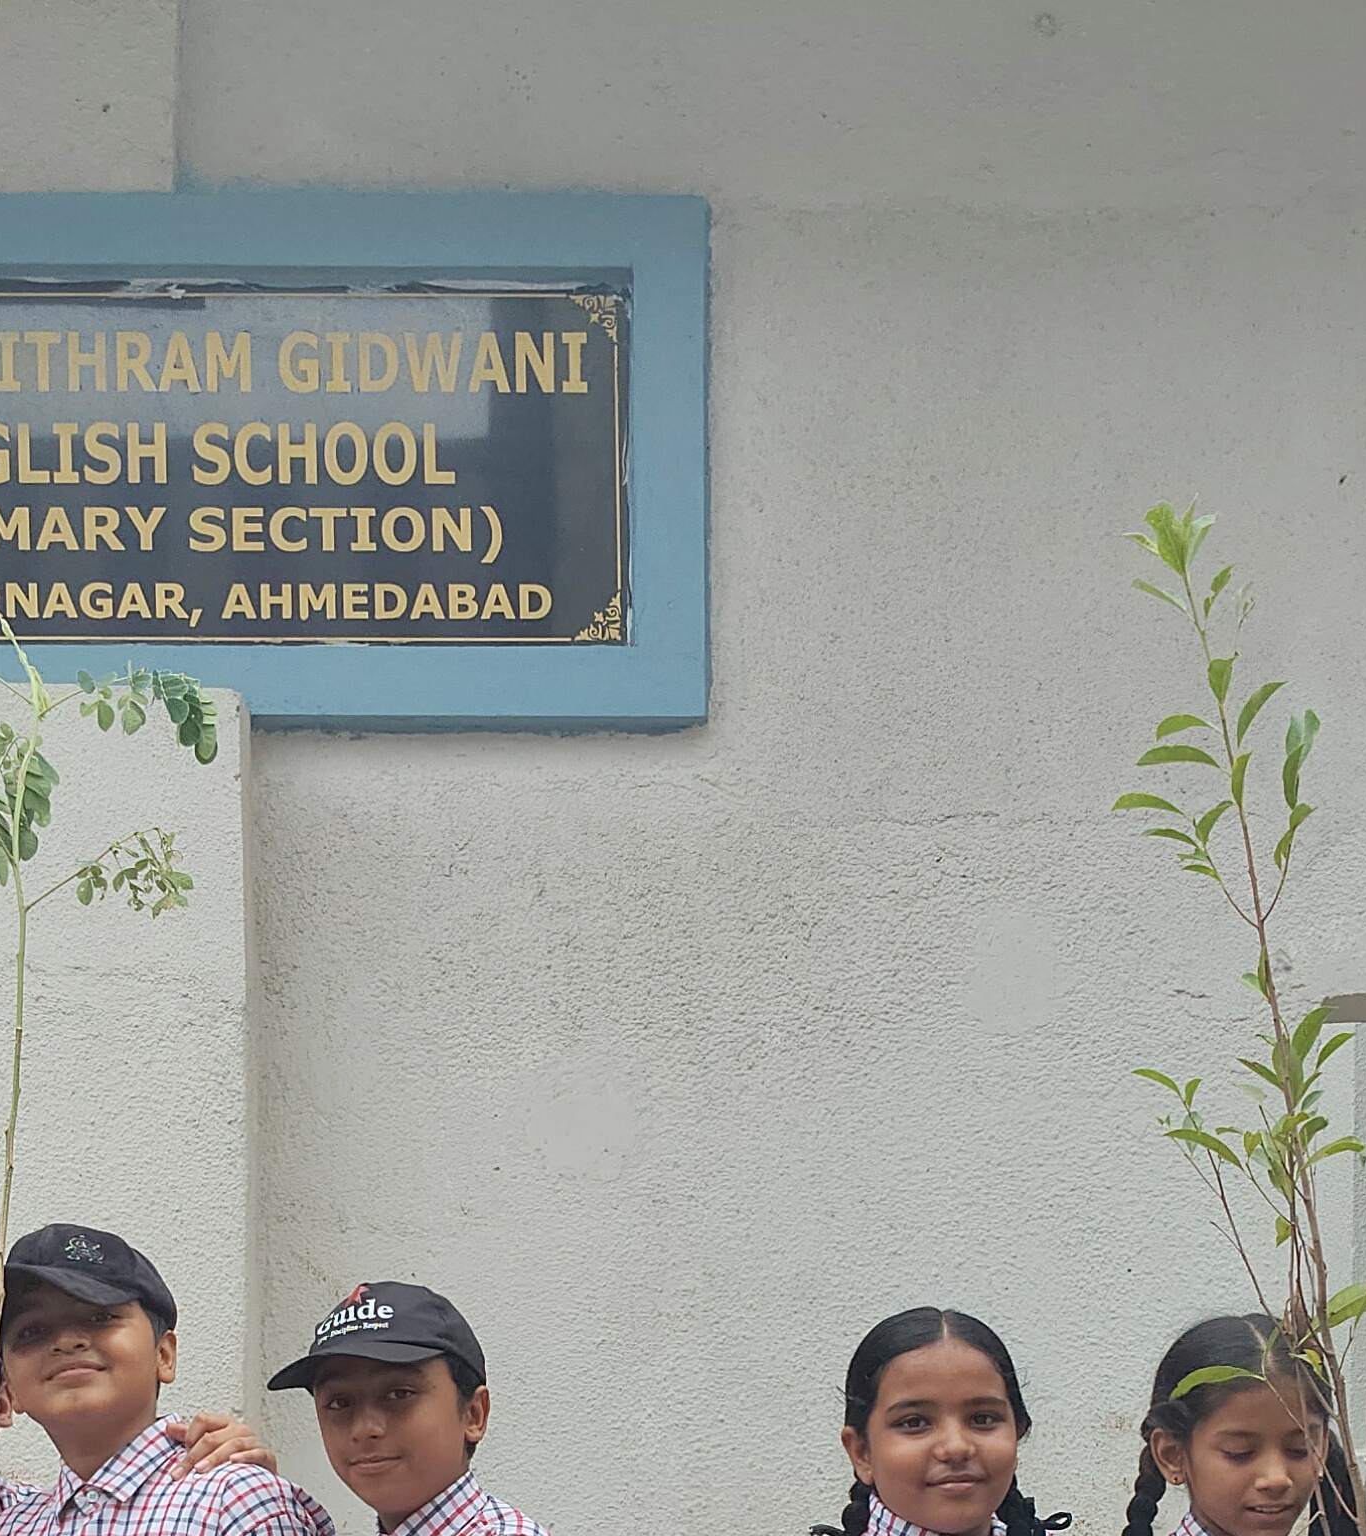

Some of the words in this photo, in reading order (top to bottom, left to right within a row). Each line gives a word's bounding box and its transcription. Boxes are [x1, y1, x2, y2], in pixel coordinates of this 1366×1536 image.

[278, 331, 589, 394] GIDWANI
[192, 421, 456, 486] SCHOOL
[187, 505, 503, 564] SECTION)
[221, 581, 552, 620] AHMEDABAD
